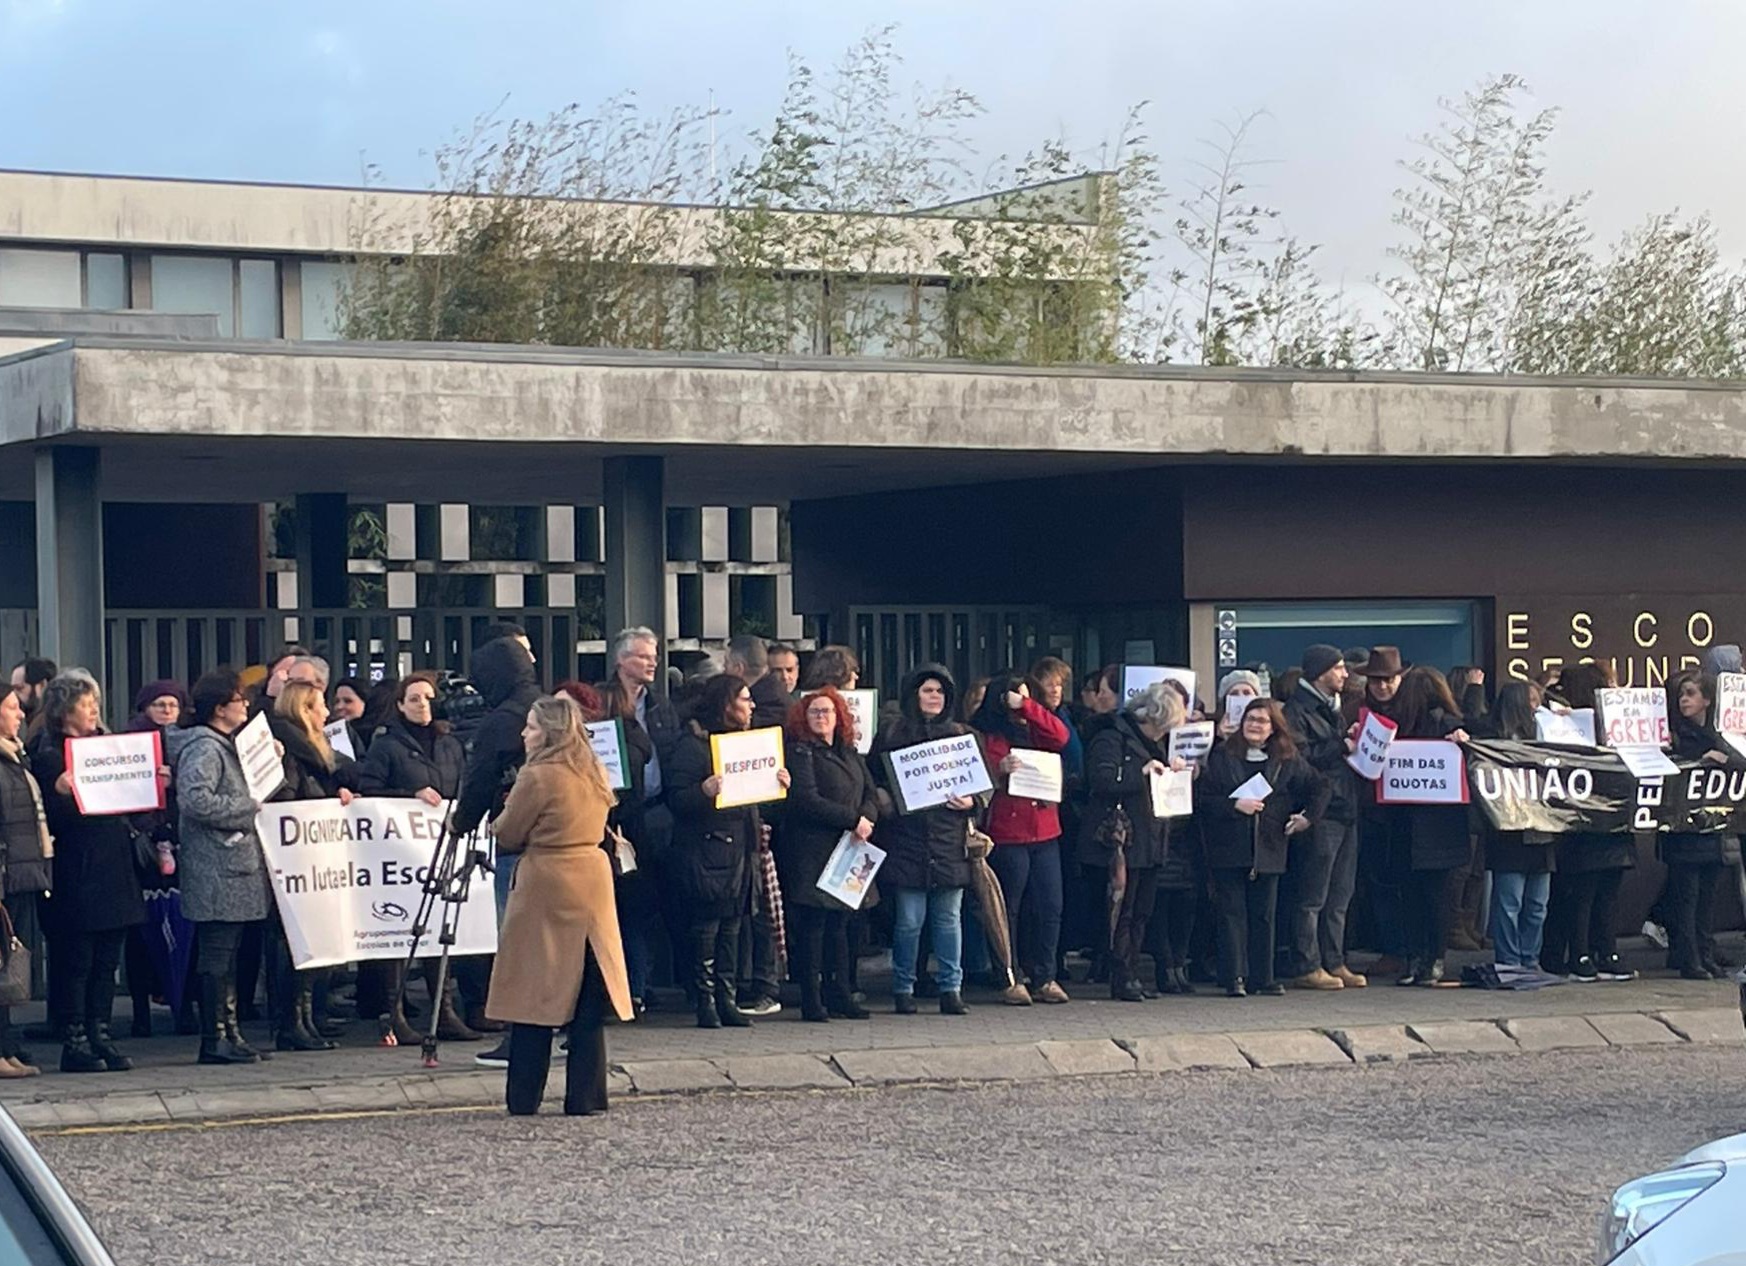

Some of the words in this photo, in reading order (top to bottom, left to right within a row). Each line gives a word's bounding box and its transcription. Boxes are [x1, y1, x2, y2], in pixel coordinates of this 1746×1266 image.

[1604, 689, 1665, 706] ESTAMOS
[1623, 708, 1641, 716] EM
[1610, 717, 1669, 743] GREVE
[84, 753, 147, 768] CONCURSOS
[900, 740, 973, 763] MOBILIDADE
[725, 756, 776, 774] RESPEITO
[905, 767, 930, 779] POR
[933, 755, 979, 773] DOENÇA
[1389, 758, 1414, 769] FIM
[1418, 758, 1446, 770] DAS
[926, 771, 974, 791] JUSTA!
[1390, 778, 1447, 789] QUOTAS
[1477, 758, 1593, 801] UNIÃO
[1634, 775, 1664, 829] PEL
[384, 817, 402, 840] A
